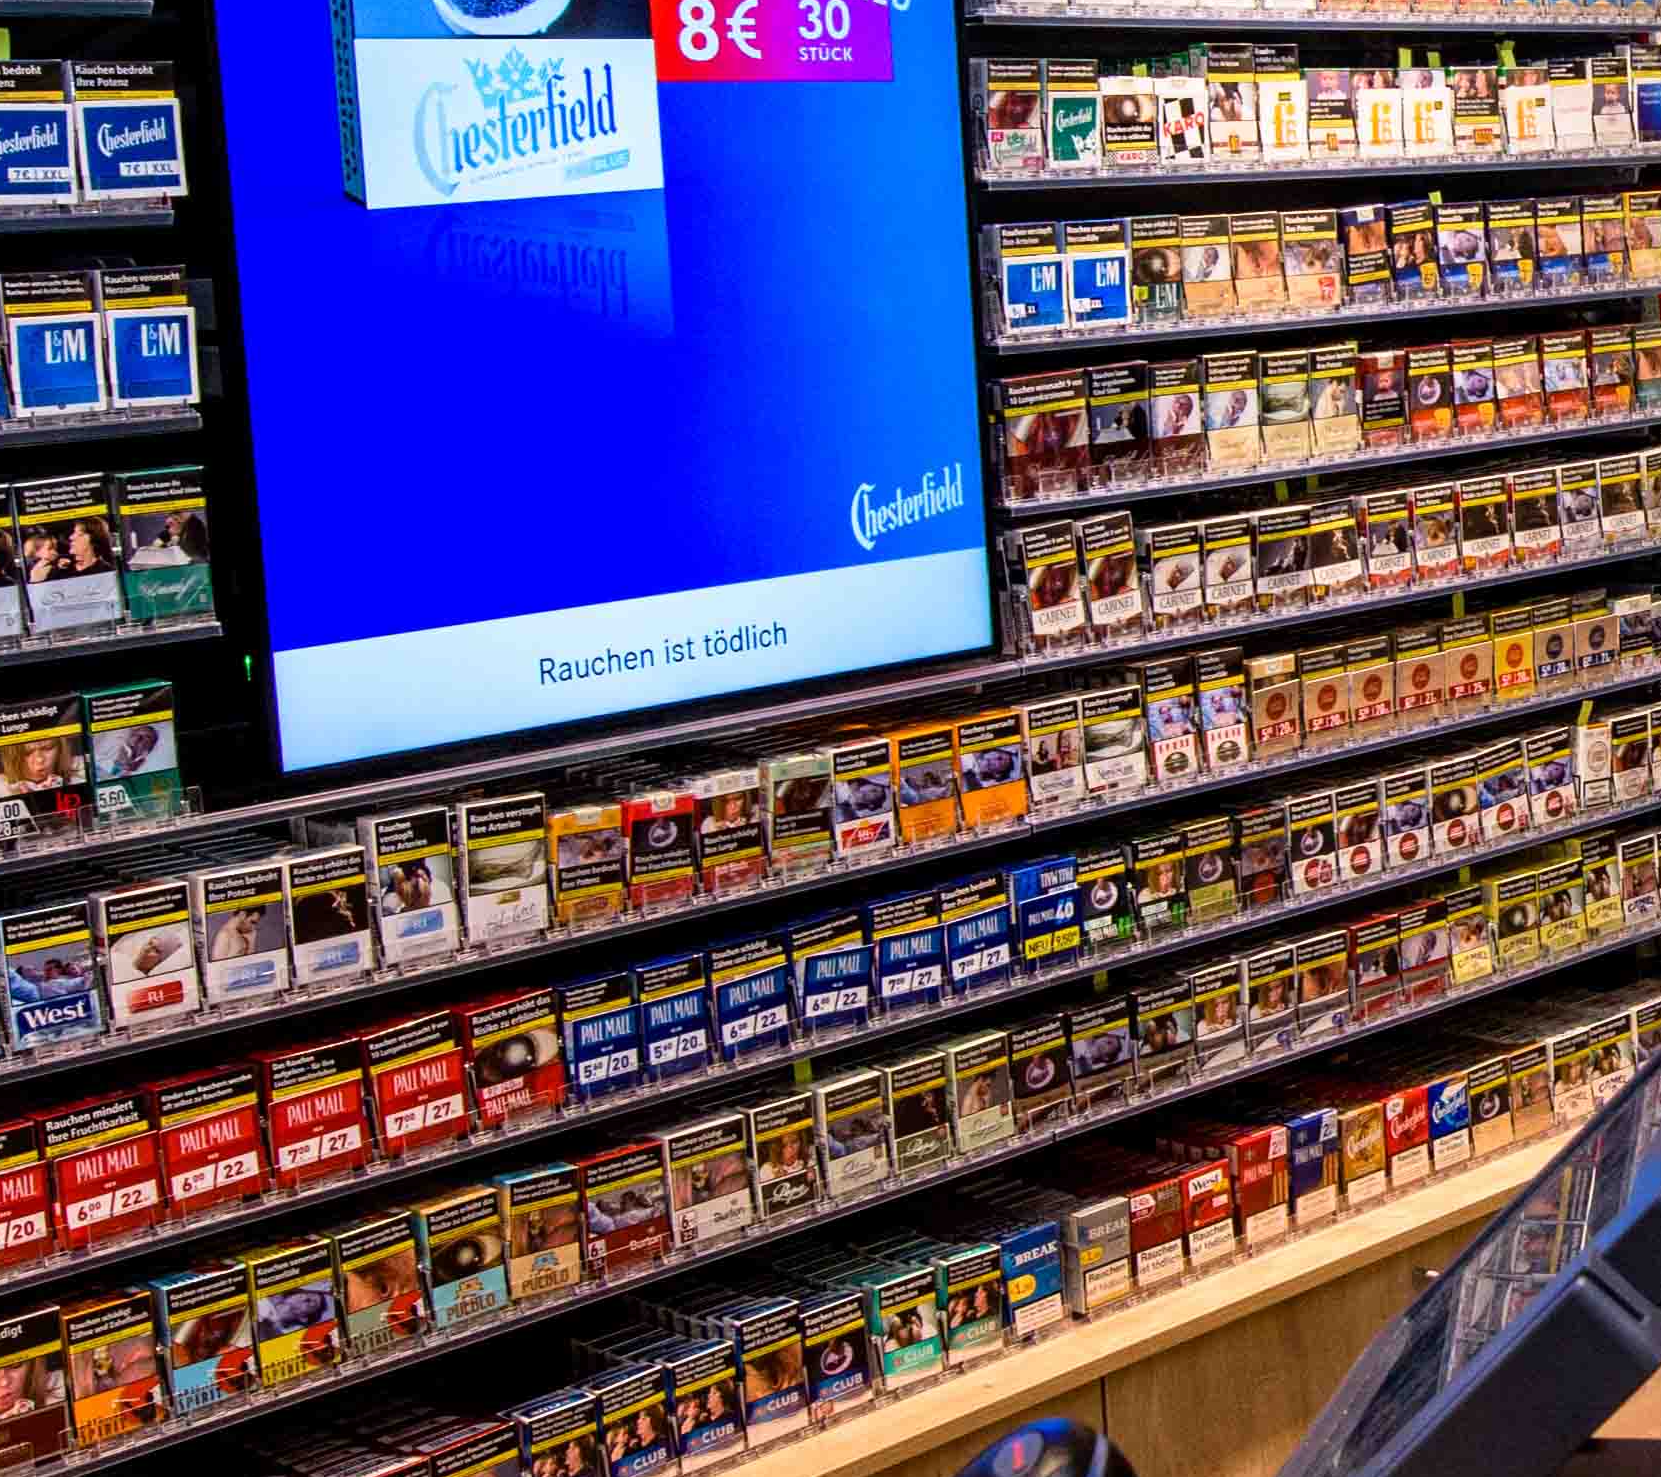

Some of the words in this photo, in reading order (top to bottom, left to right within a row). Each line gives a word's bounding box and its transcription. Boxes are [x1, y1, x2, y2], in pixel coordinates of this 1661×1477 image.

[798, 44, 854, 63] STÜCK
[414, 64, 618, 197] Chesterfield
[850, 464, 965, 551] Chesterfield
[537, 642, 656, 687] Rauchen
[663, 639, 697, 669] ist
[704, 621, 788, 662] tödlich
